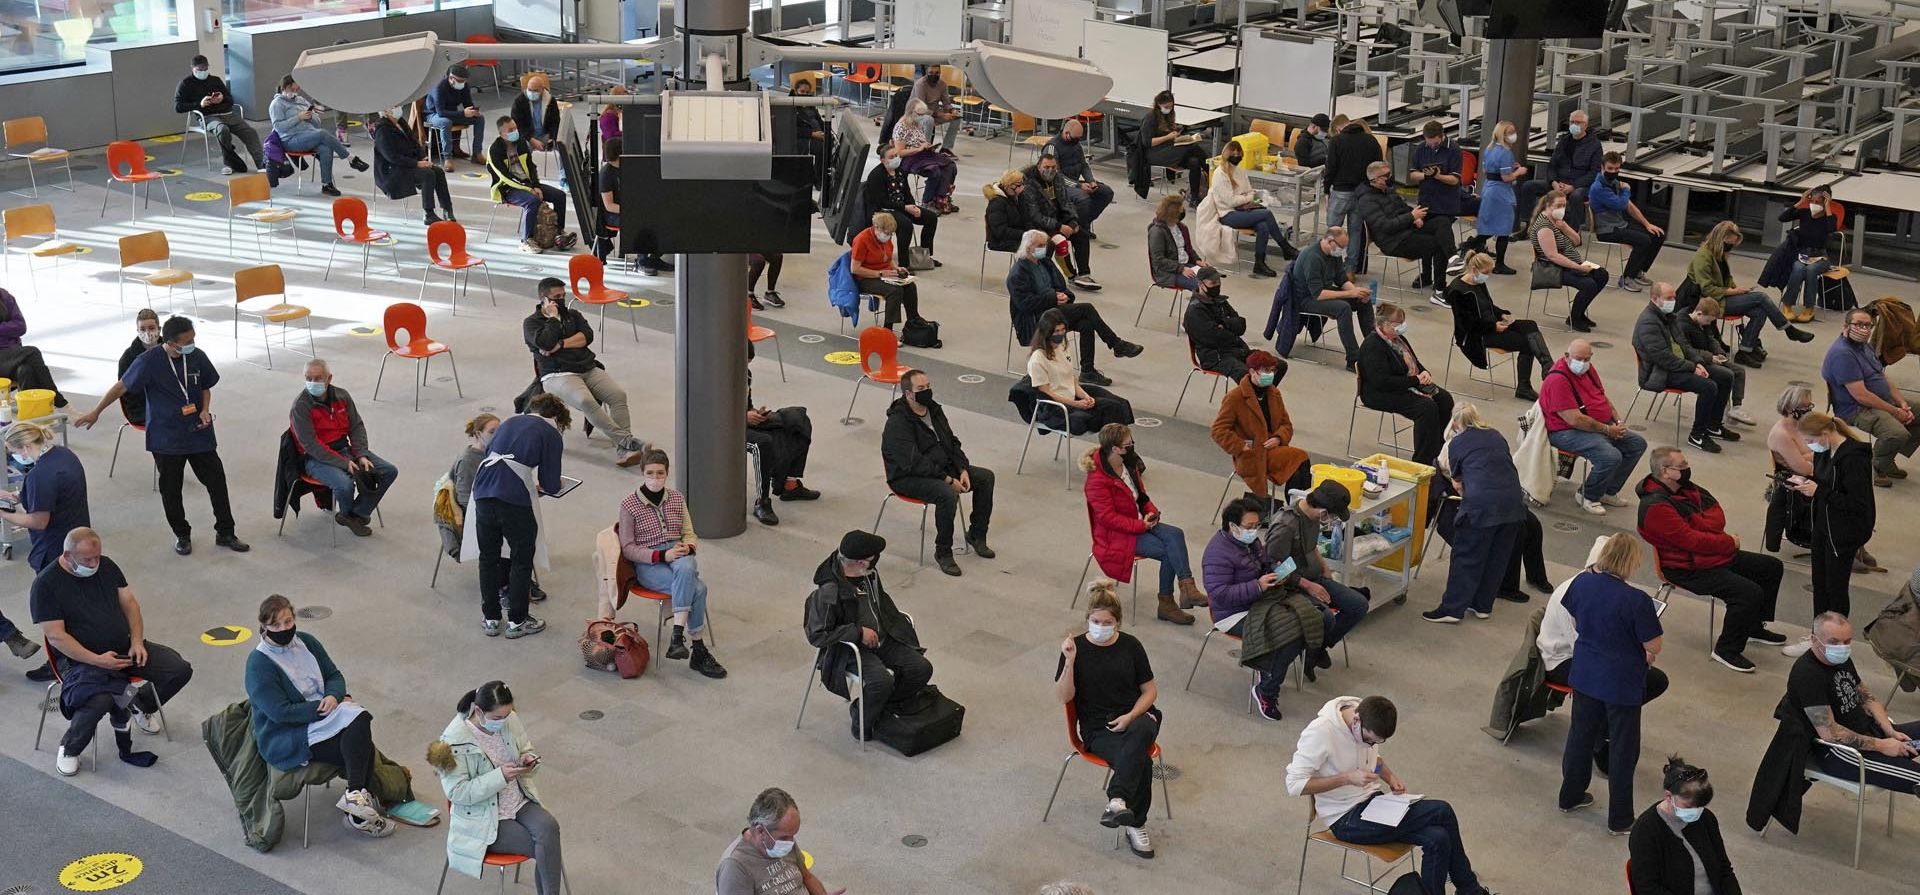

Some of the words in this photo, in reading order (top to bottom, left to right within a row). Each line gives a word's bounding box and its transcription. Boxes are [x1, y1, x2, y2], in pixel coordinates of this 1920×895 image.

[74, 859, 118, 879] distance
[86, 865, 126, 882] 2m
[766, 861, 781, 876] THIS
[761, 881, 771, 892] MY
